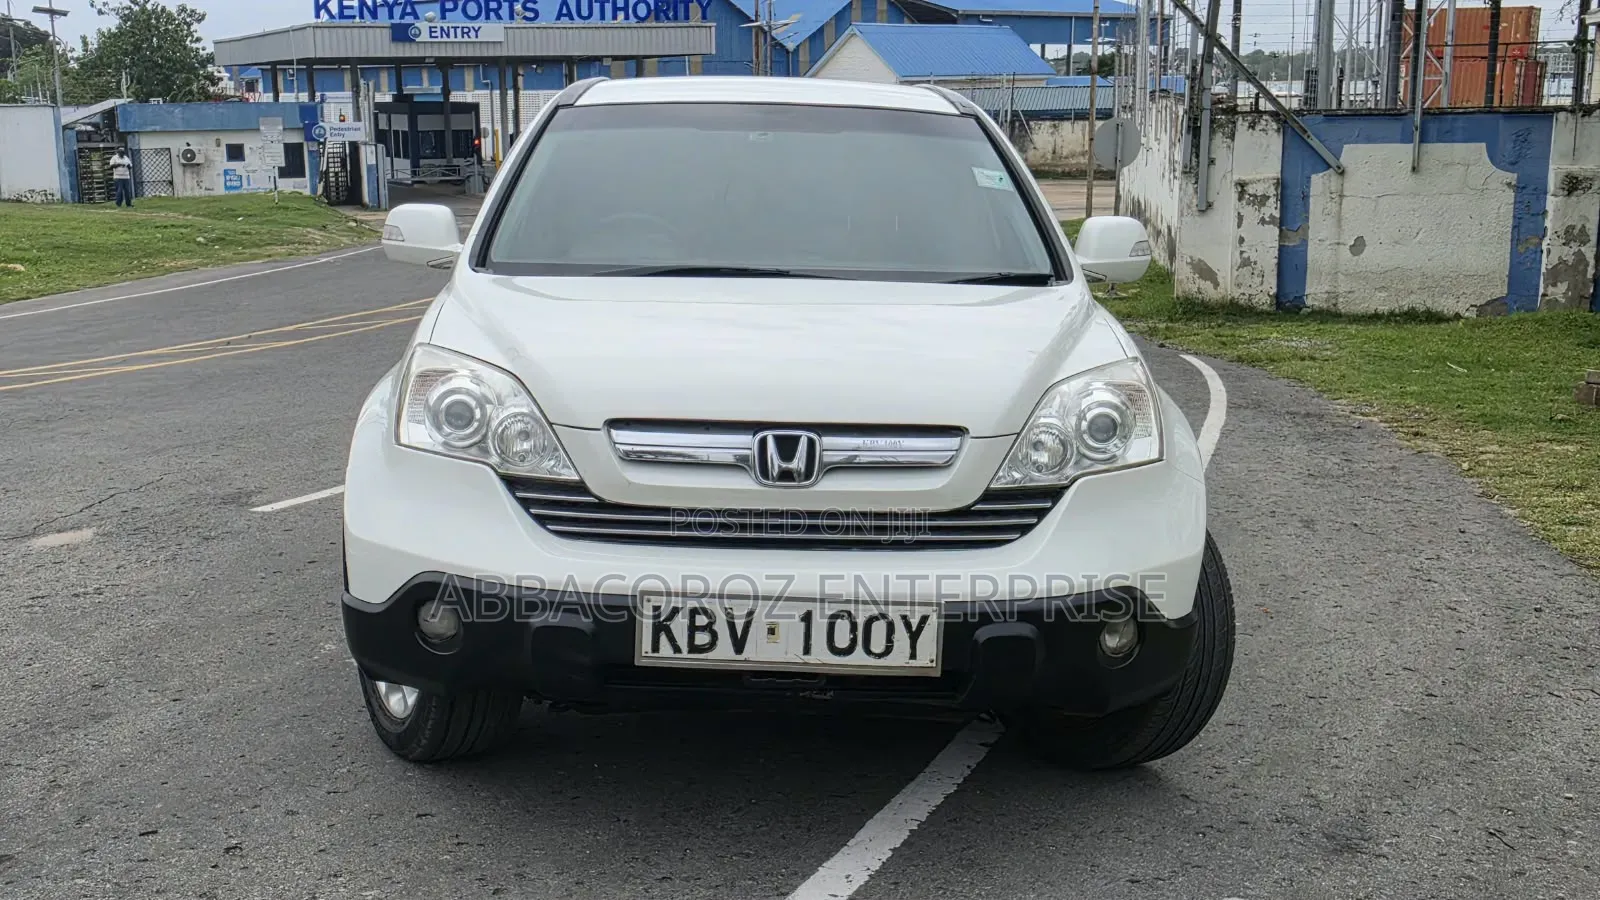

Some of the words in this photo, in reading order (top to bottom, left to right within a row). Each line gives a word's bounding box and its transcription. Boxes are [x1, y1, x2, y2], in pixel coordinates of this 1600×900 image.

[314, 0, 420, 20] KENYA
[440, 0, 540, 22] PORTS
[555, 0, 713, 22] AUTHORITY
[429, 26, 482, 39] ENTRY
[651, 604, 755, 656] KBV
[799, 608, 931, 661] 100Y
